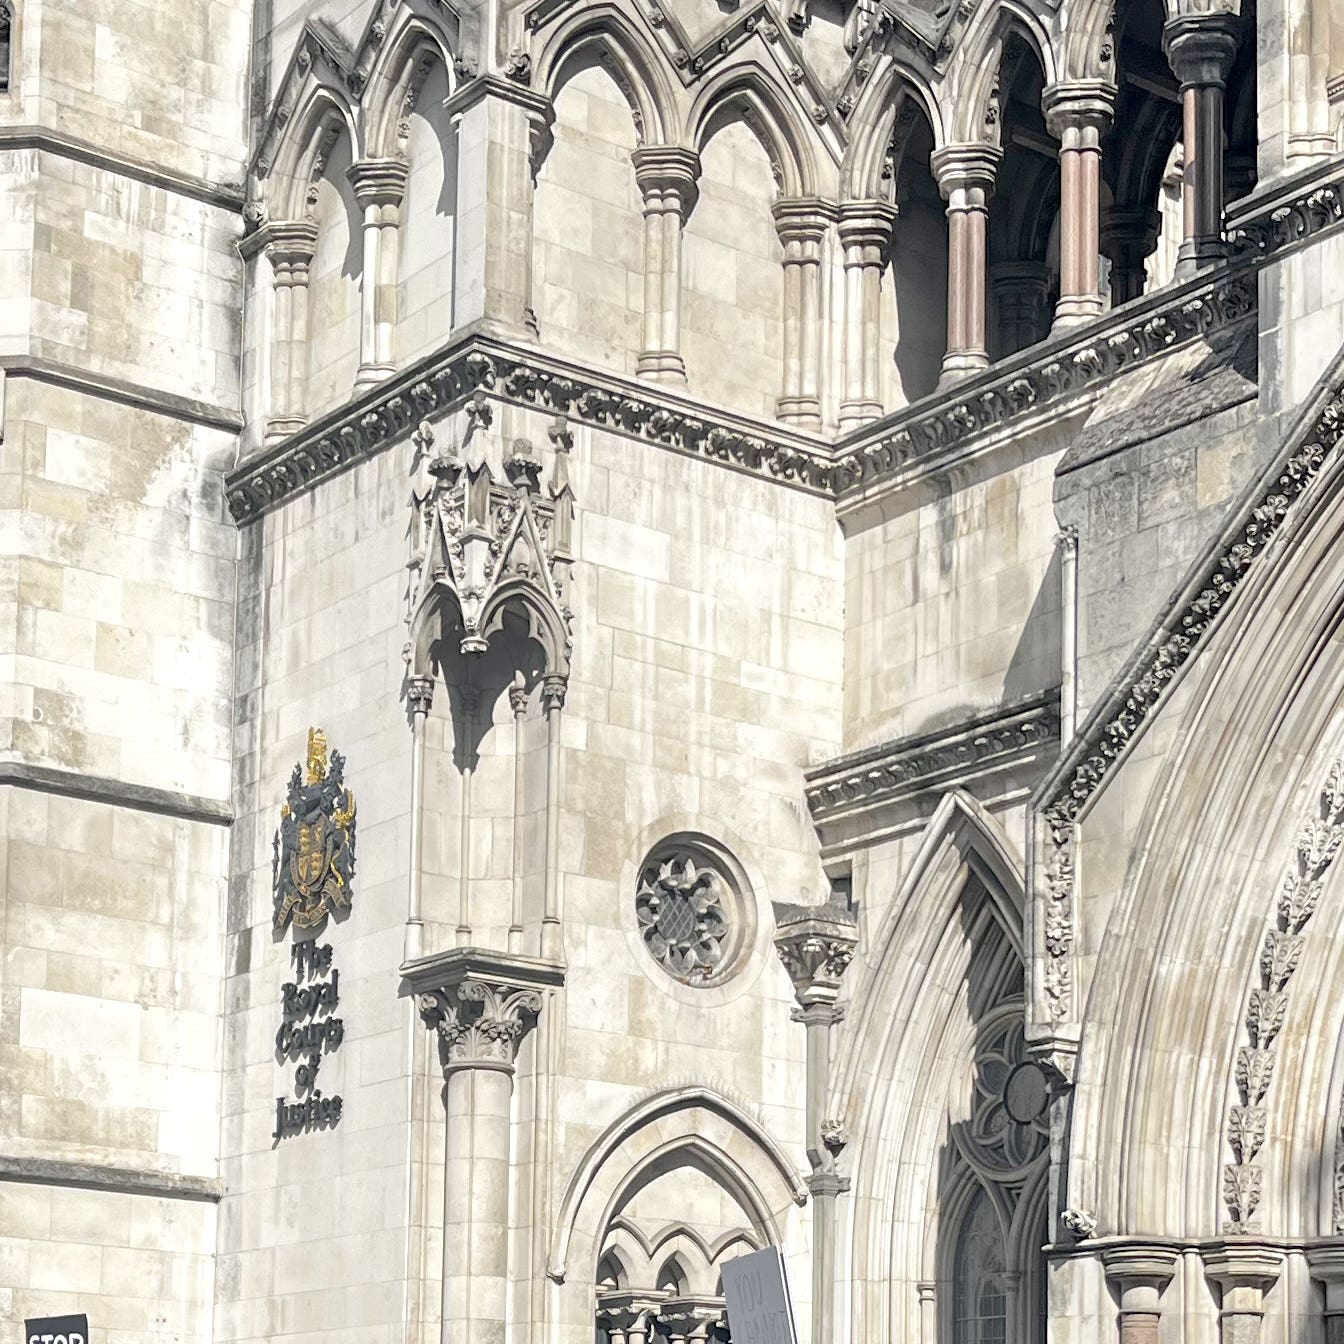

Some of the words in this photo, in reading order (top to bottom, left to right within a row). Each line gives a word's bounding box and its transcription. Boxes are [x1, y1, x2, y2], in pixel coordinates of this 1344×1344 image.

[291, 941, 333, 977] The
[281, 969, 339, 1020] Royal
[276, 1016, 344, 1054] Courts
[295, 1053, 321, 1087] of
[272, 1089, 343, 1140] Justice
